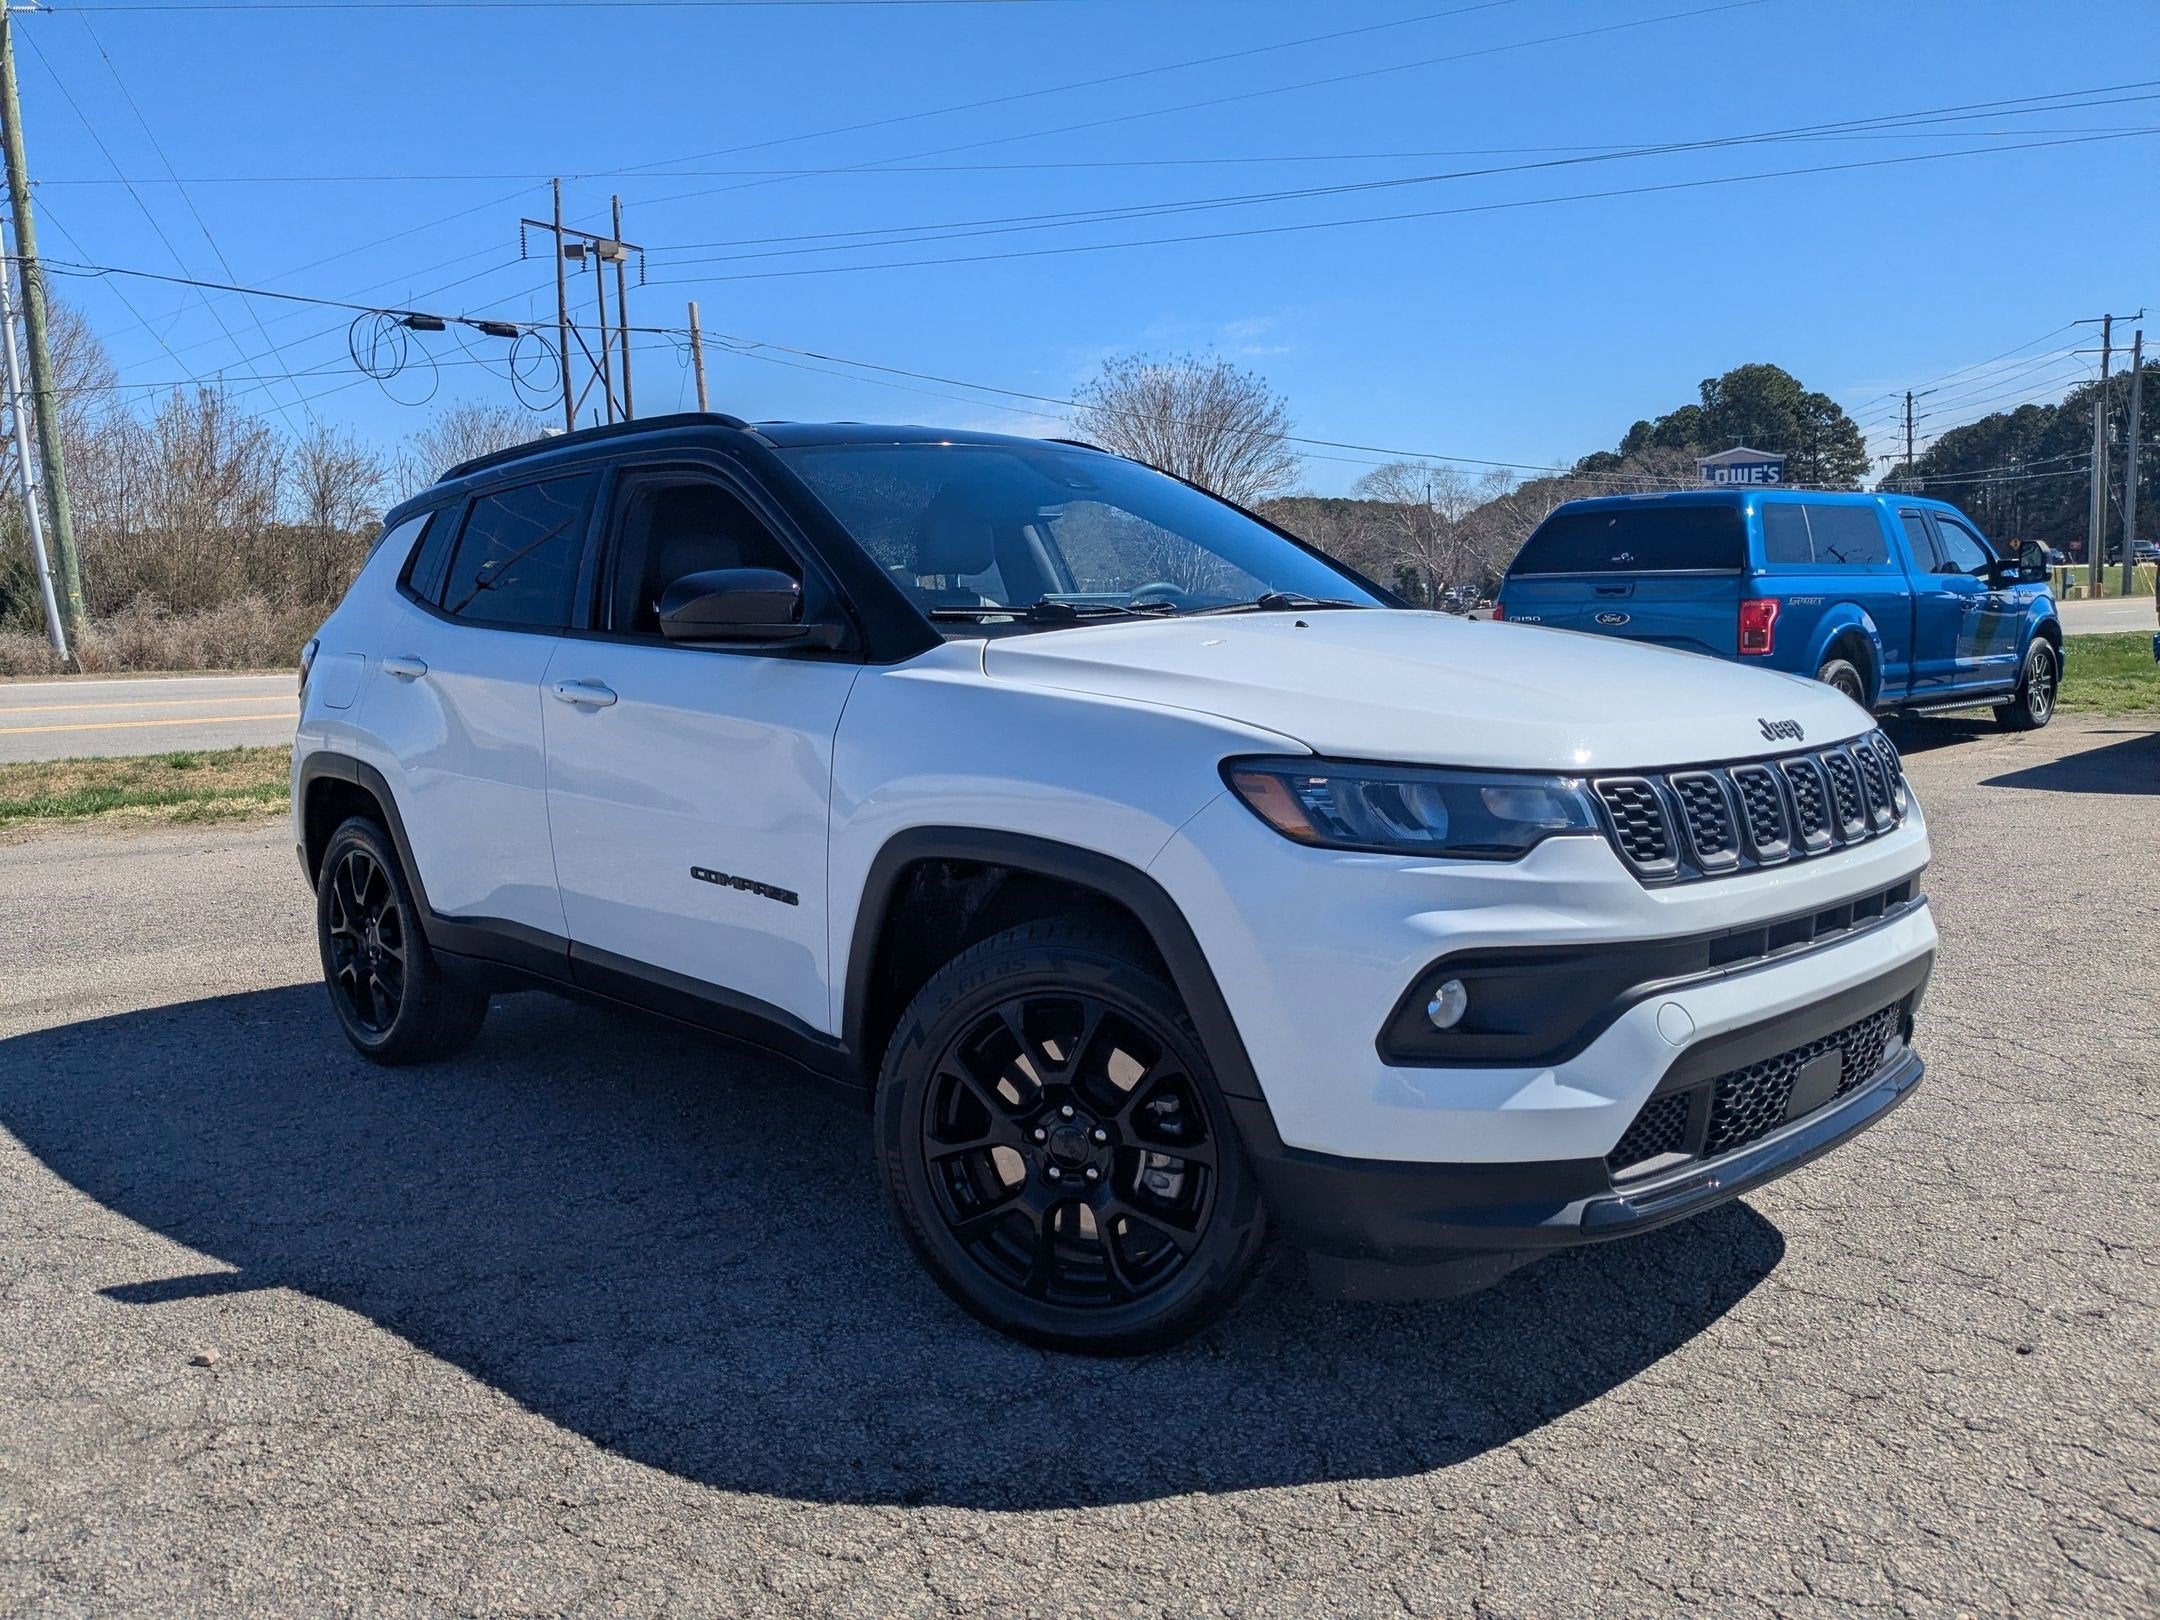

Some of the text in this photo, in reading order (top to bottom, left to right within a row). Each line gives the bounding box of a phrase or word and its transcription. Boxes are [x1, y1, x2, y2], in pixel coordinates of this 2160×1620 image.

[1701, 464, 1780, 485] LOWE'S
[1600, 612, 1624, 623] Ford
[1757, 718, 1804, 742] Jeep
[690, 866, 799, 906] COMPASS
